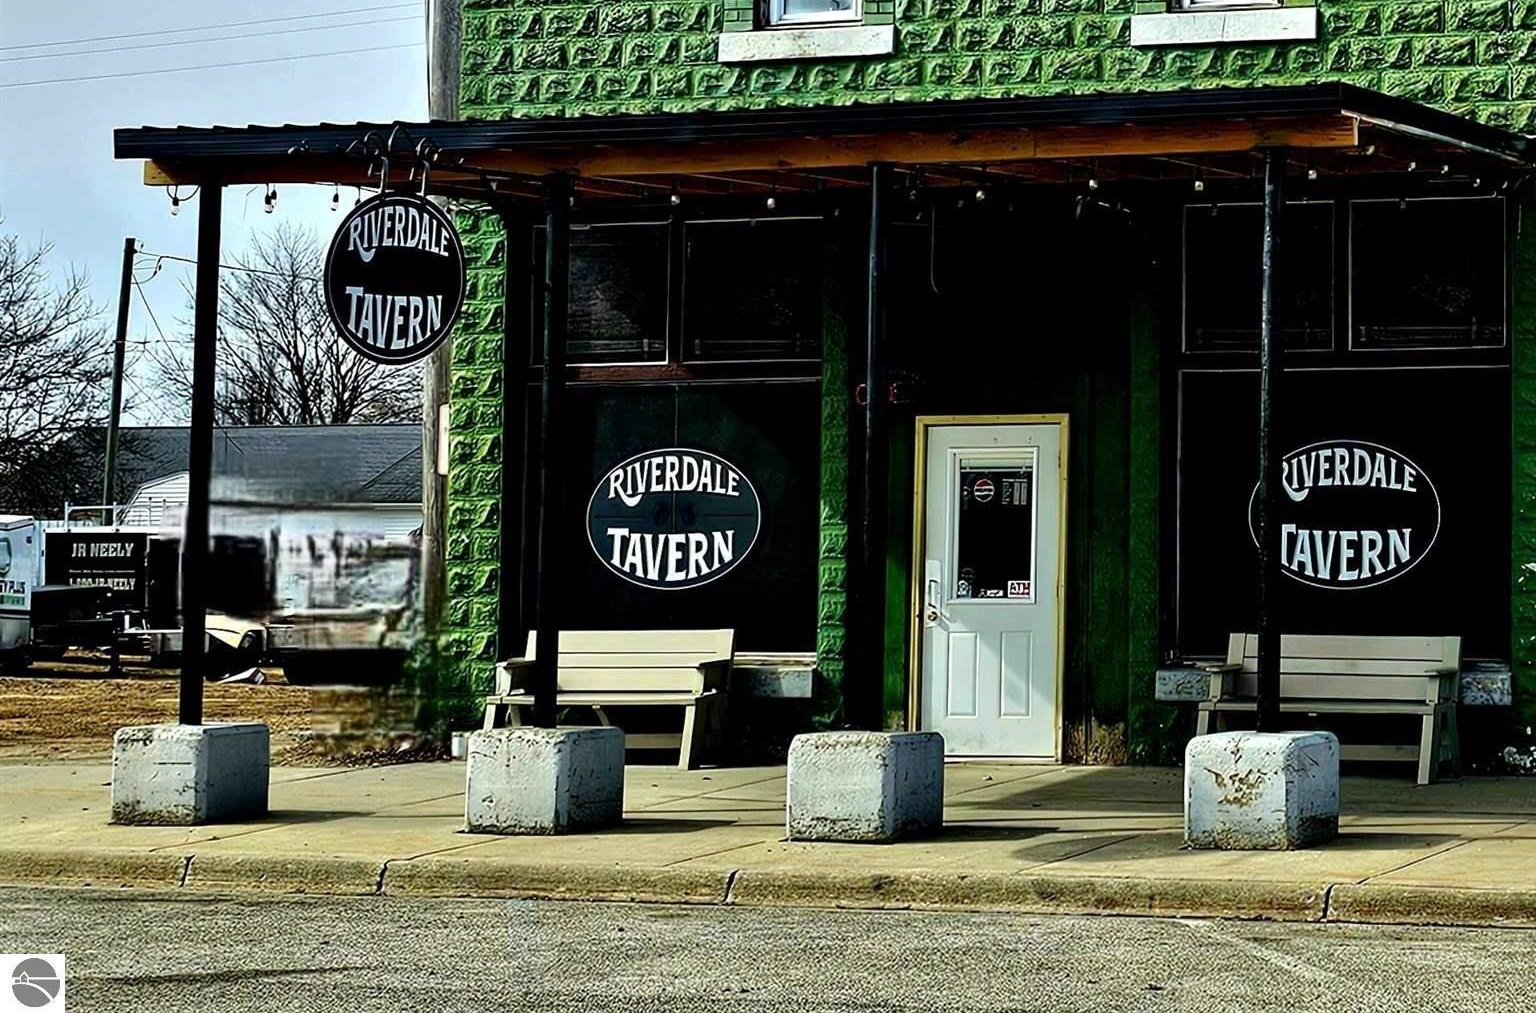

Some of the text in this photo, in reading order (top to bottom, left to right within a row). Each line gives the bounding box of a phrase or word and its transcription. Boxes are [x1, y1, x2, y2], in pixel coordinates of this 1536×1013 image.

[348, 205, 450, 263] RIVERDALE
[345, 286, 443, 350] TAVERN
[607, 455, 740, 507] RIVERDALE
[71, 542, 135, 557] JR NEELY
[606, 527, 735, 582] TAVERN
